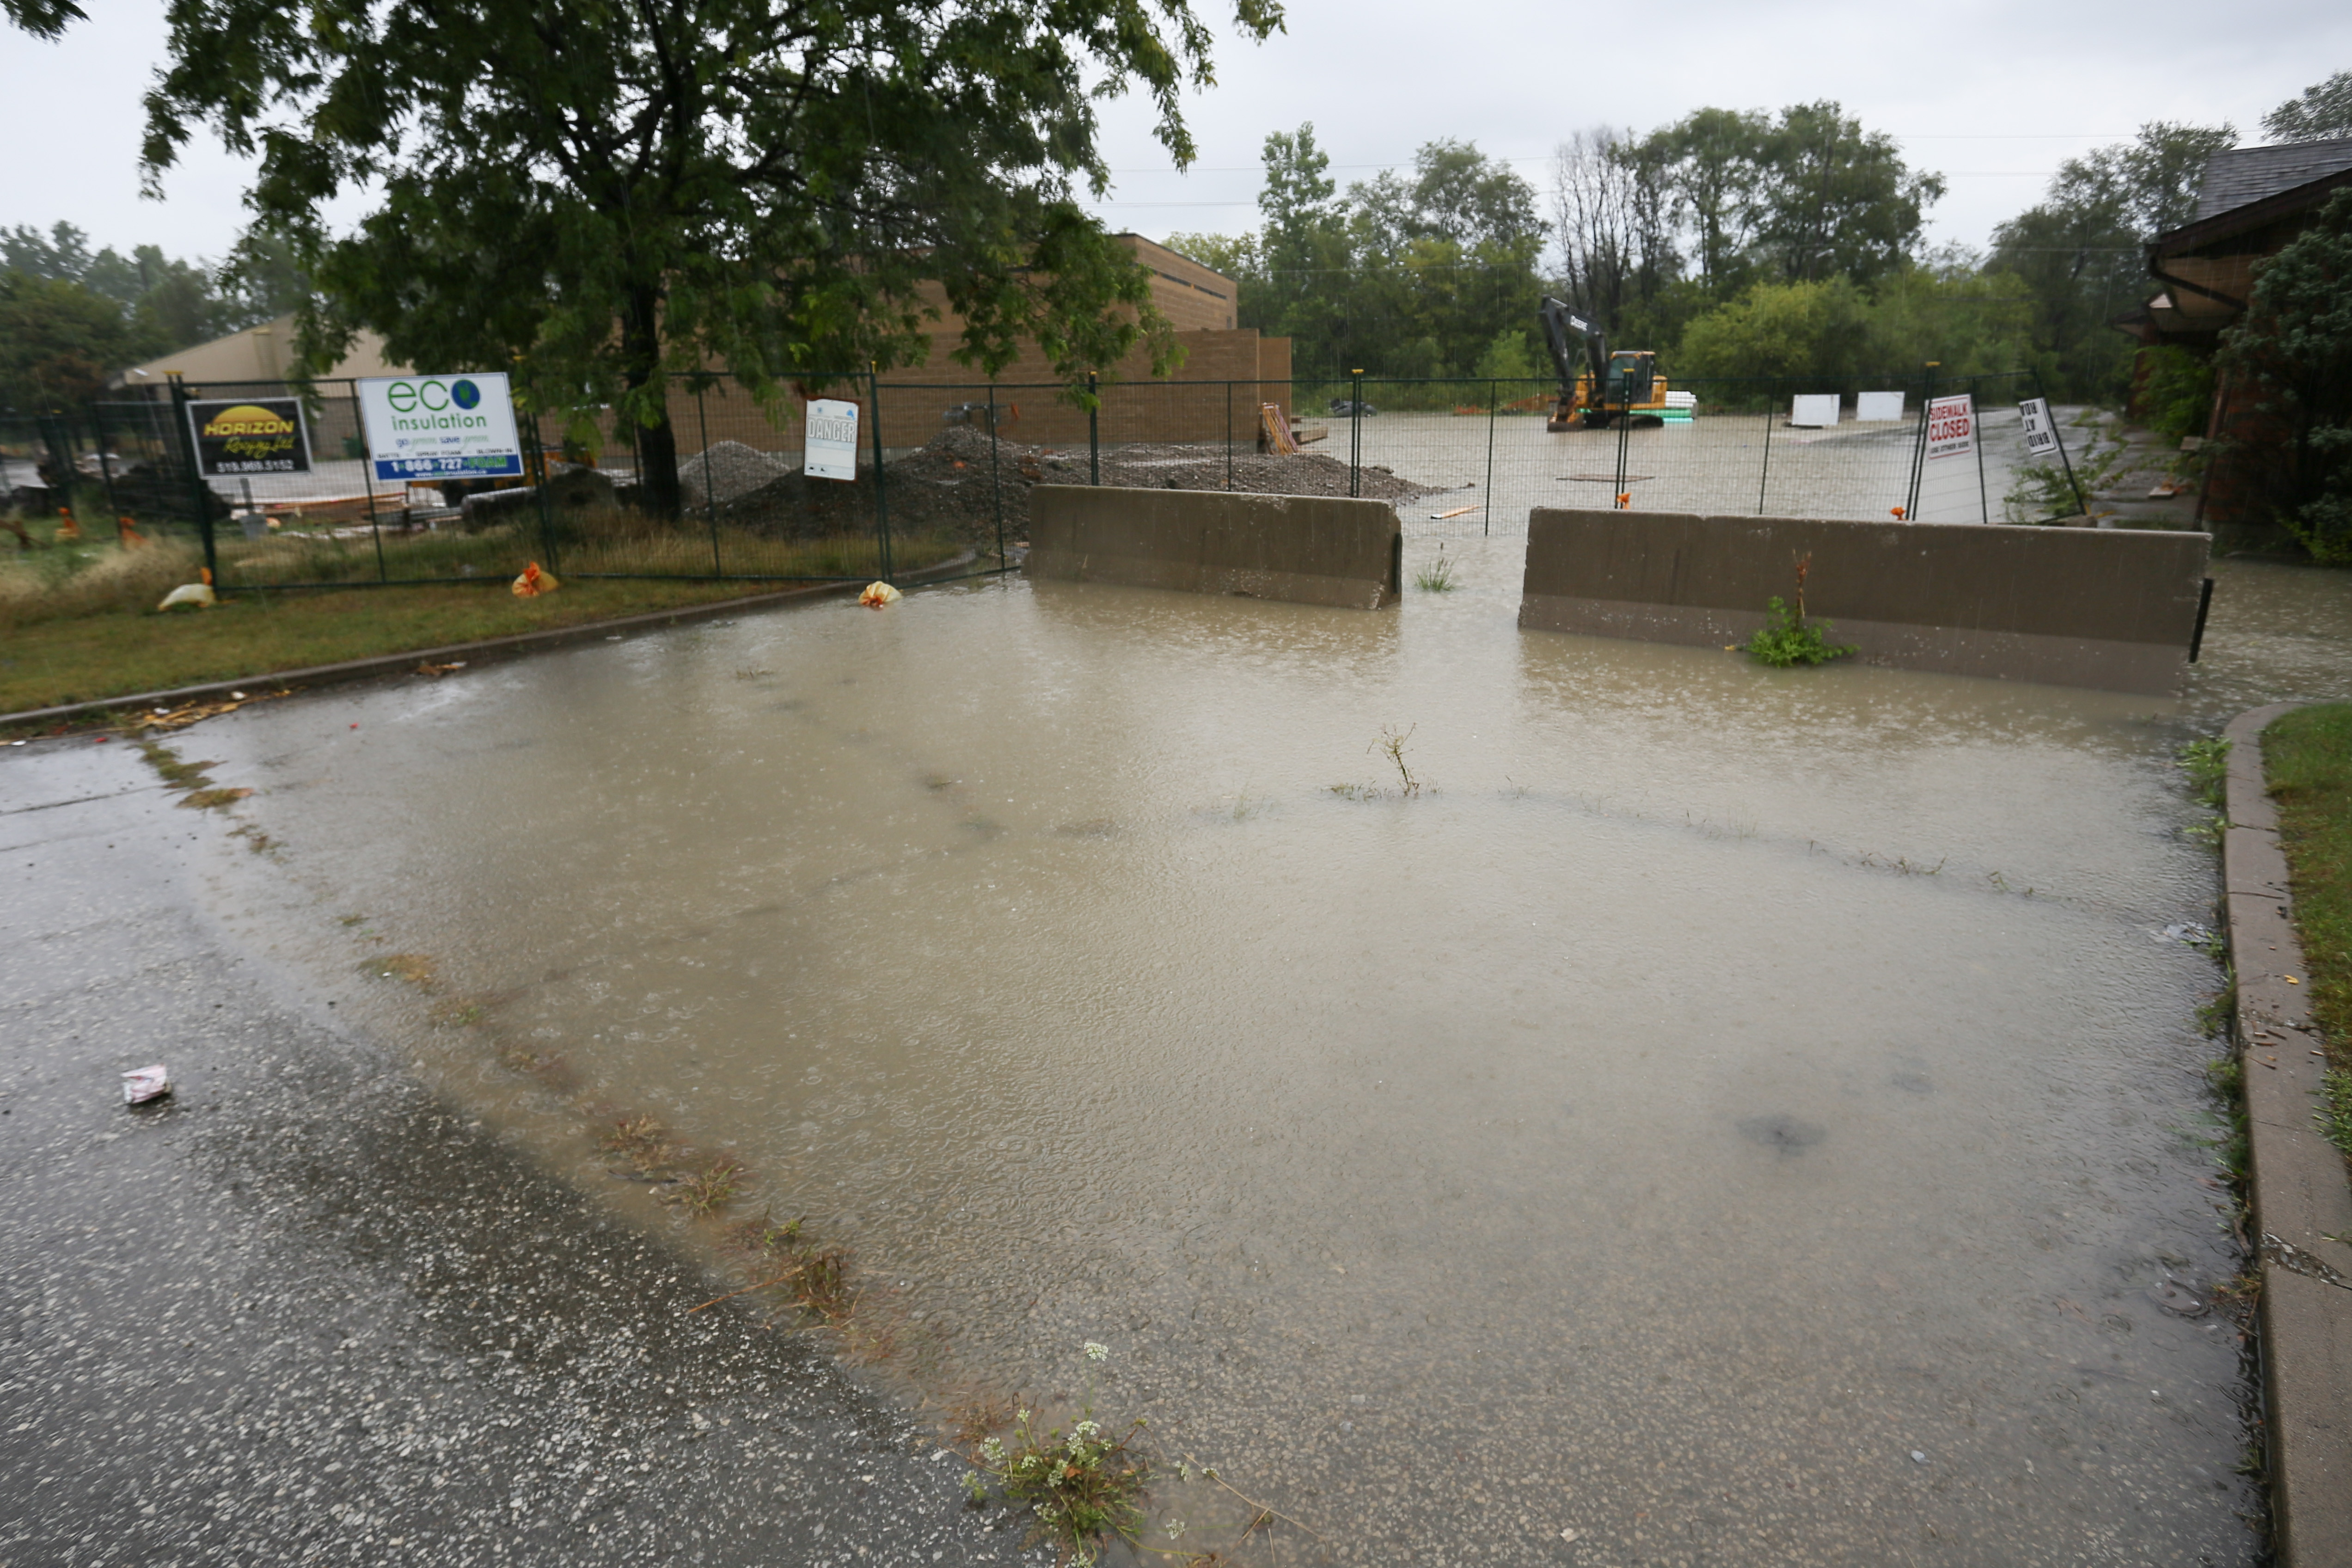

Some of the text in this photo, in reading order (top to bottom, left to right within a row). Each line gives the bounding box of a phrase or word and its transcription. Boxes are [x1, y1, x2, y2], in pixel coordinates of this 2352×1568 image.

[1570, 315, 1588, 332] DEERE
[1929, 403, 1967, 421] SIDEWALK
[203, 420, 294, 436] HORIZON
[391, 413, 487, 431] insulation
[807, 417, 855, 443] DANGER
[1929, 418, 1970, 441] CLOSED
[2025, 419, 2035, 432] AT
[396, 439, 409, 448] go
[440, 436, 460, 444] save
[2028, 432, 2050, 447] BRID
